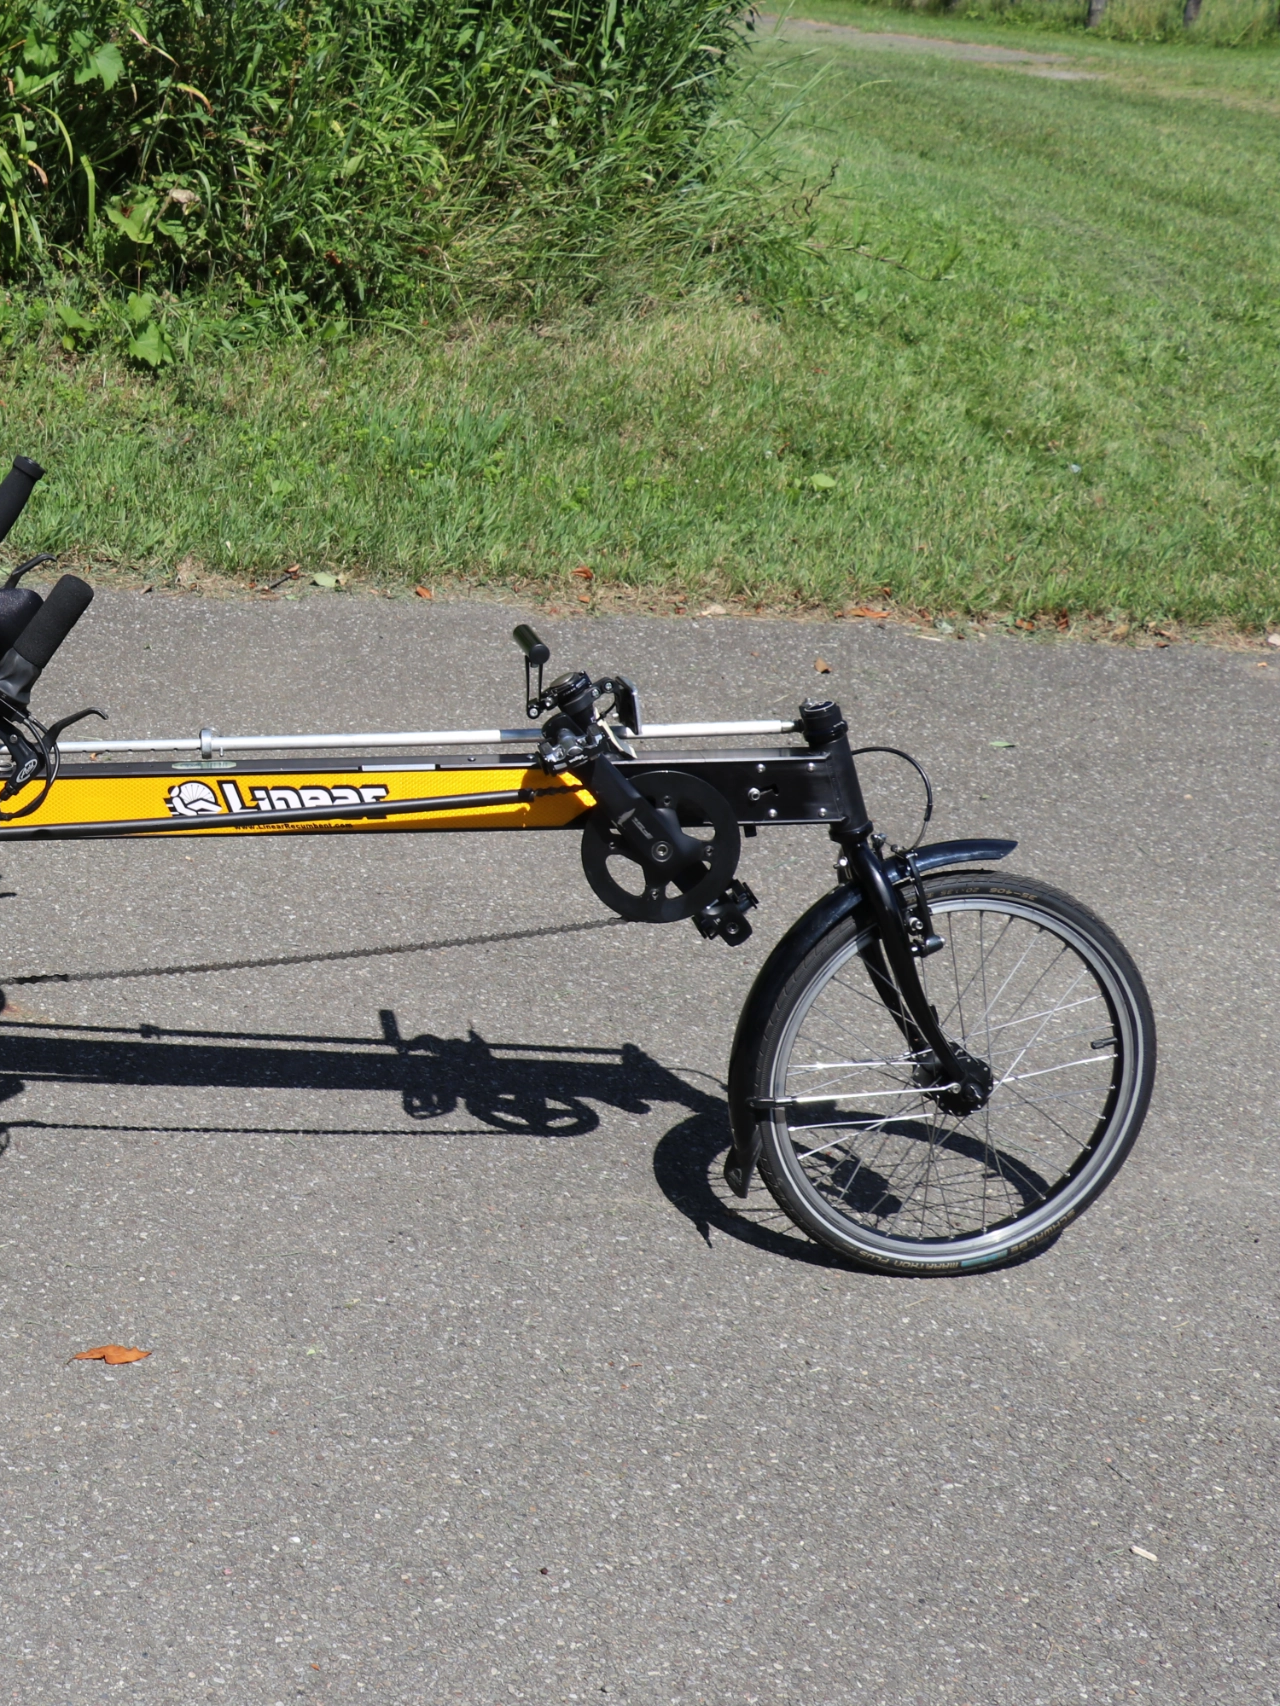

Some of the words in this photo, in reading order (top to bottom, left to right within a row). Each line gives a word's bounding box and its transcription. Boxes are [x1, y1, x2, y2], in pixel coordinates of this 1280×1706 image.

[1009, 1208, 1076, 1254] SCHWALBE
[858, 1250, 890, 1264] PLUS
[893, 1259, 959, 1271] MARATHON
